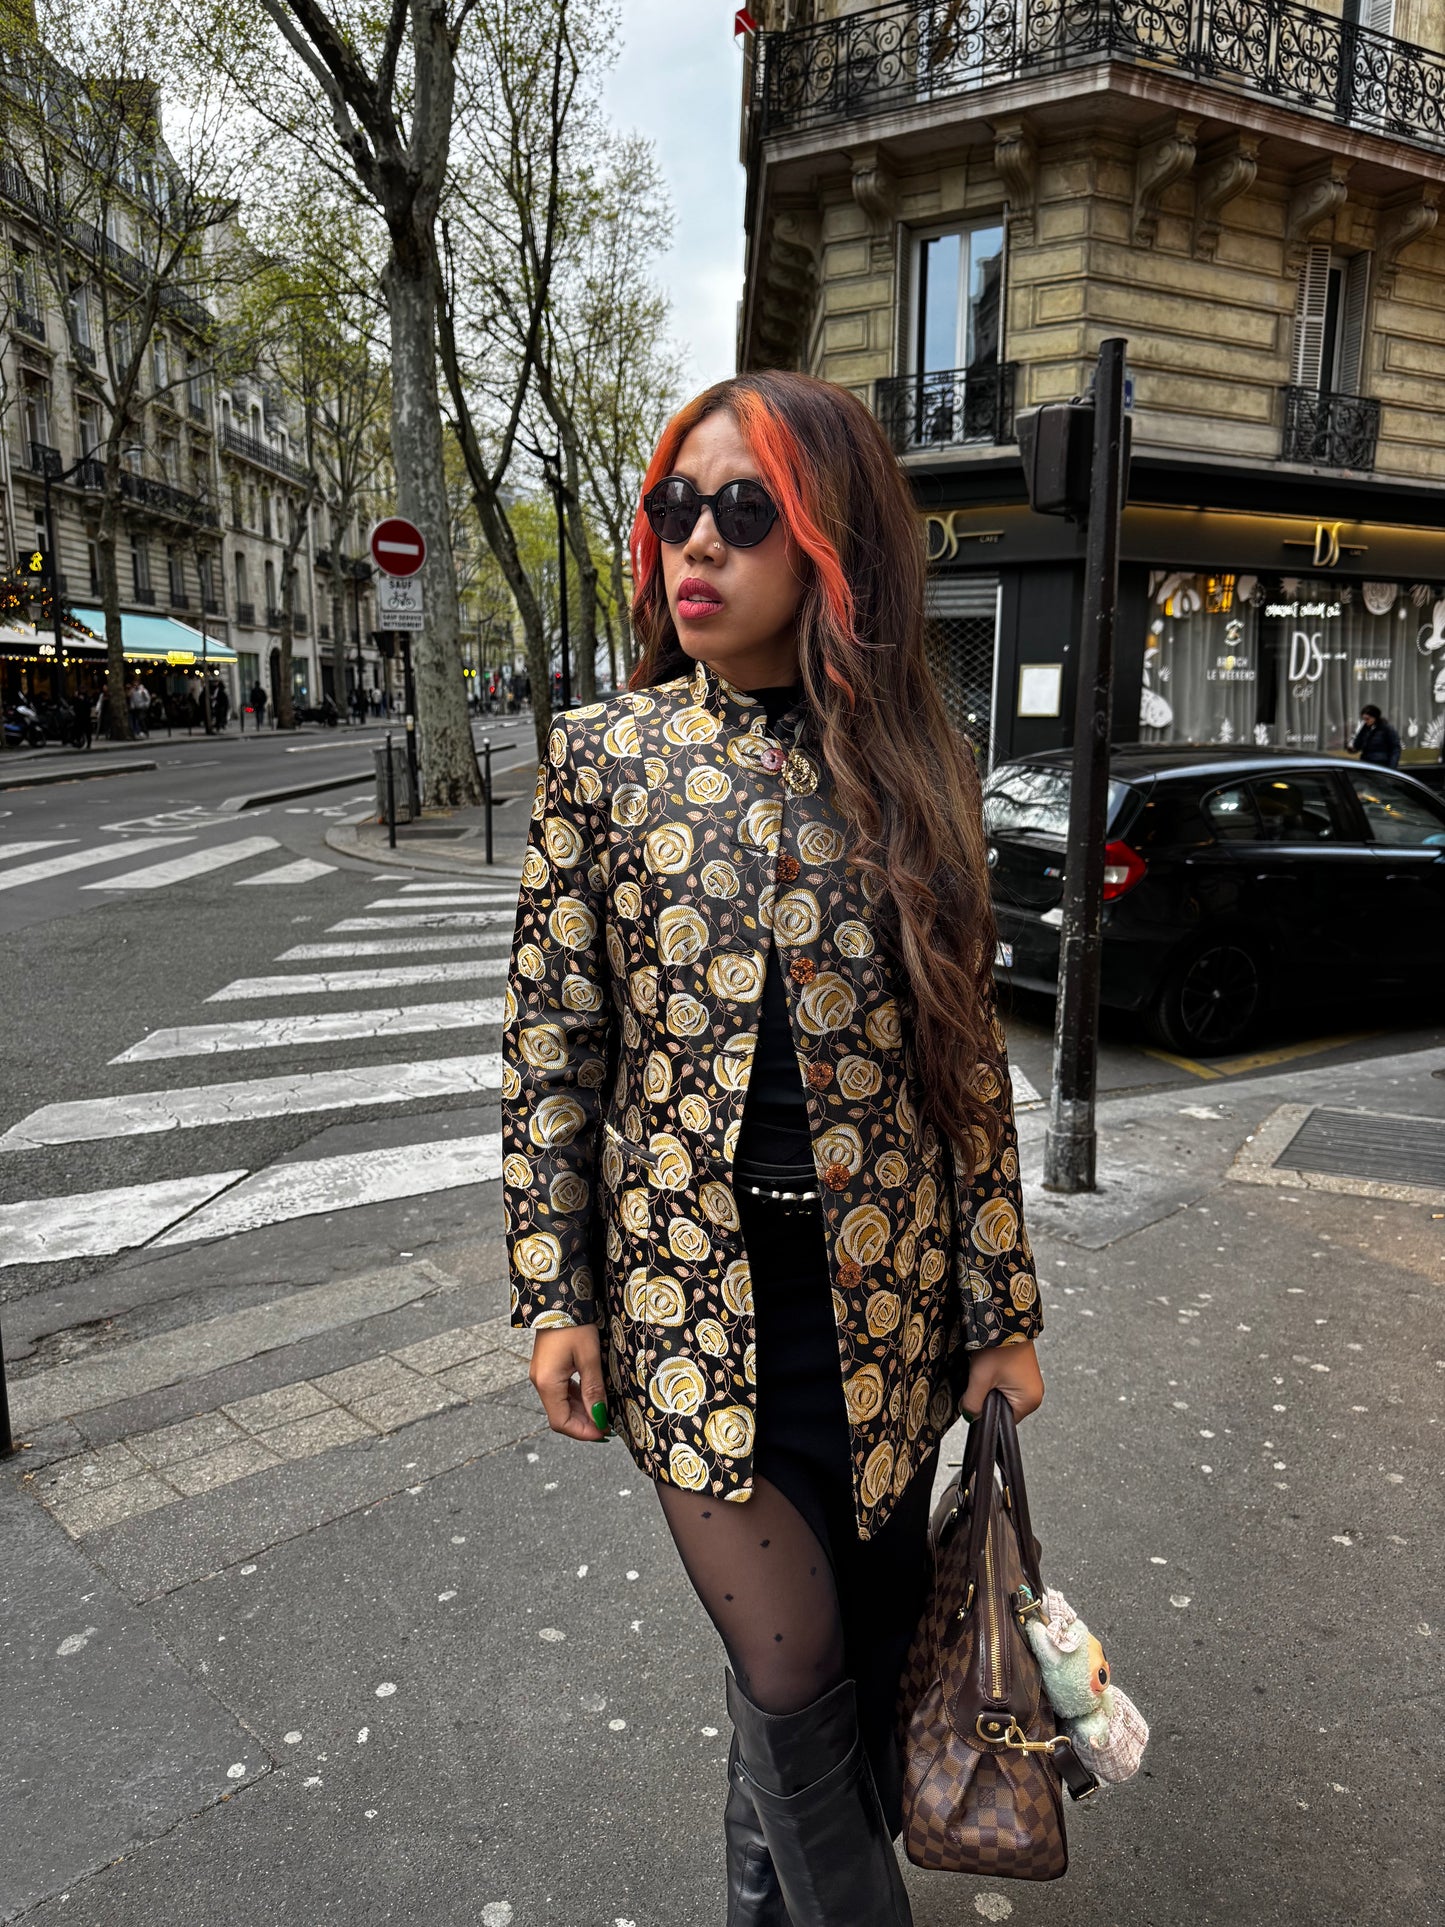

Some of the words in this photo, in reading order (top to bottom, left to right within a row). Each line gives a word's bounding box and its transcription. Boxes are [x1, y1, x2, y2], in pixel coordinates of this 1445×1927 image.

[1313, 522, 1343, 567] DS
[389, 580, 412, 589] SAUF
[1289, 632, 1323, 681] DS
[1207, 670, 1216, 680] LE
[1219, 670, 1255, 681] WEEKEND
[1365, 671, 1388, 681] LUNCH
